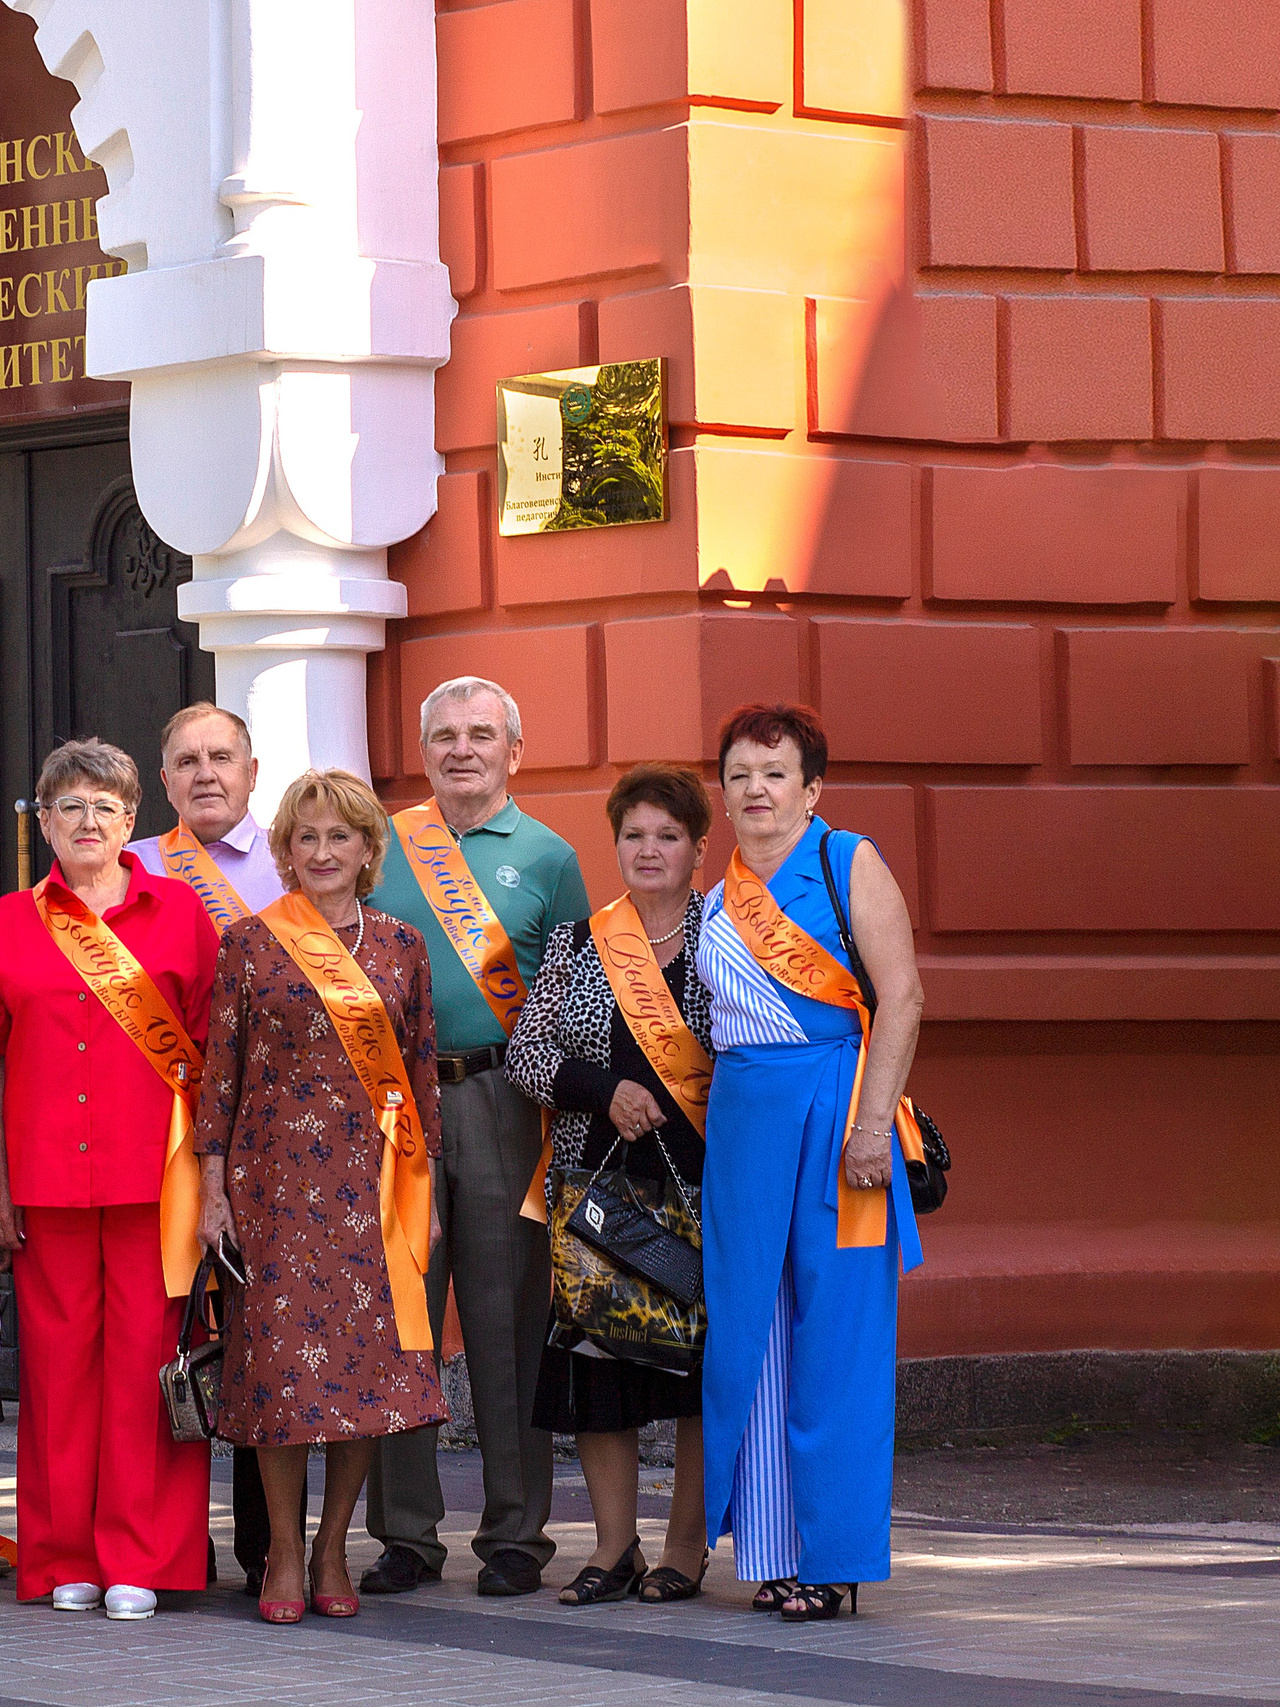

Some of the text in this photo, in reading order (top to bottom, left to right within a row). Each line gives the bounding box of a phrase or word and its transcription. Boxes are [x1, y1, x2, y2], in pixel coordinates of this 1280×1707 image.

[516, 510, 558, 522] педагогич
[408, 823, 490, 950] Выпуск
[456, 874, 474, 891] 50
[97, 934, 141, 983] 50 лет
[443, 916, 467, 947] ФВиС
[732, 880, 826, 985] Выпуск
[770, 913, 818, 959] 50 лет
[45, 898, 202, 1093] Выпуск 1973
[291, 931, 382, 1061] Выпуск
[357, 981, 376, 1000] 50
[769, 961, 803, 989] ФВиС
[91, 978, 144, 1040] ФВиС БГПИ
[602, 932, 711, 1106] Выпуск 19
[652, 987, 680, 1033] 50 лет
[339, 1023, 375, 1092] ФВиС БГПИ
[633, 1021, 679, 1087] ФВиС БГПИ
